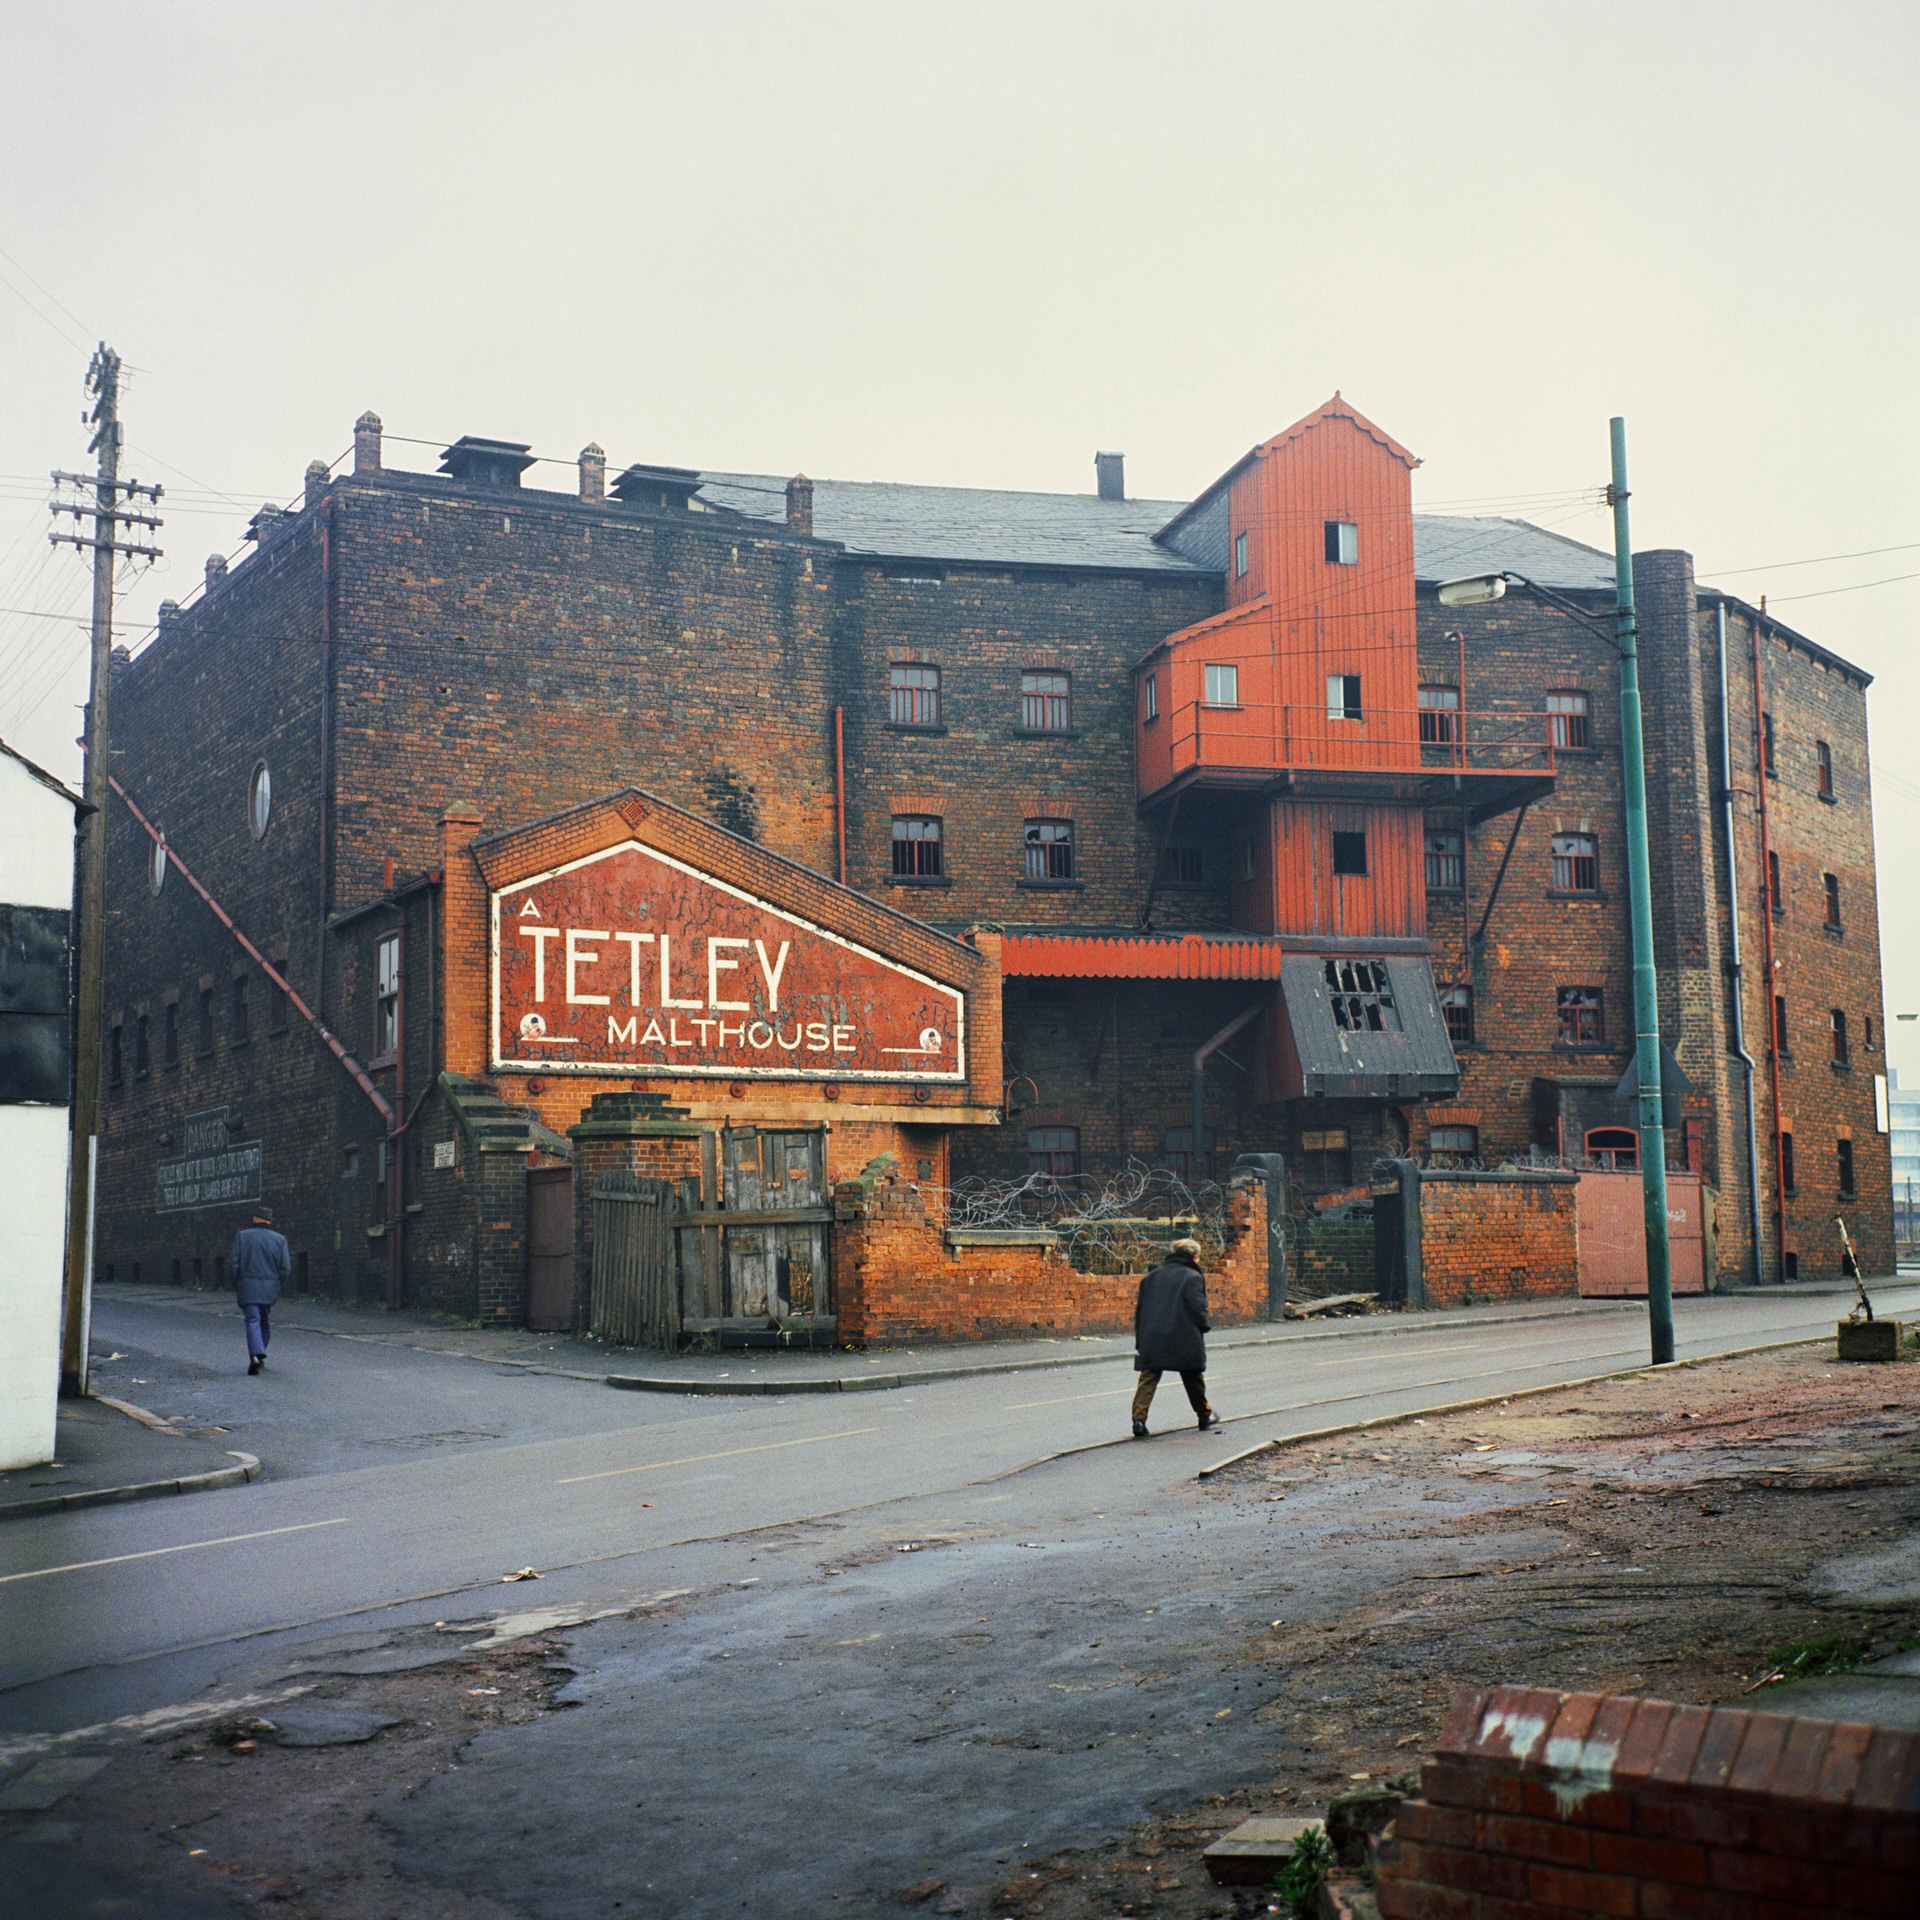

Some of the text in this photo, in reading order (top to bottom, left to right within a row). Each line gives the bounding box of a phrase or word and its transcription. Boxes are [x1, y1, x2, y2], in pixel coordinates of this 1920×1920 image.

[519, 898, 541, 918] A
[519, 926, 790, 1013] TETLEY
[607, 1016, 857, 1052] MALTHOUSE
